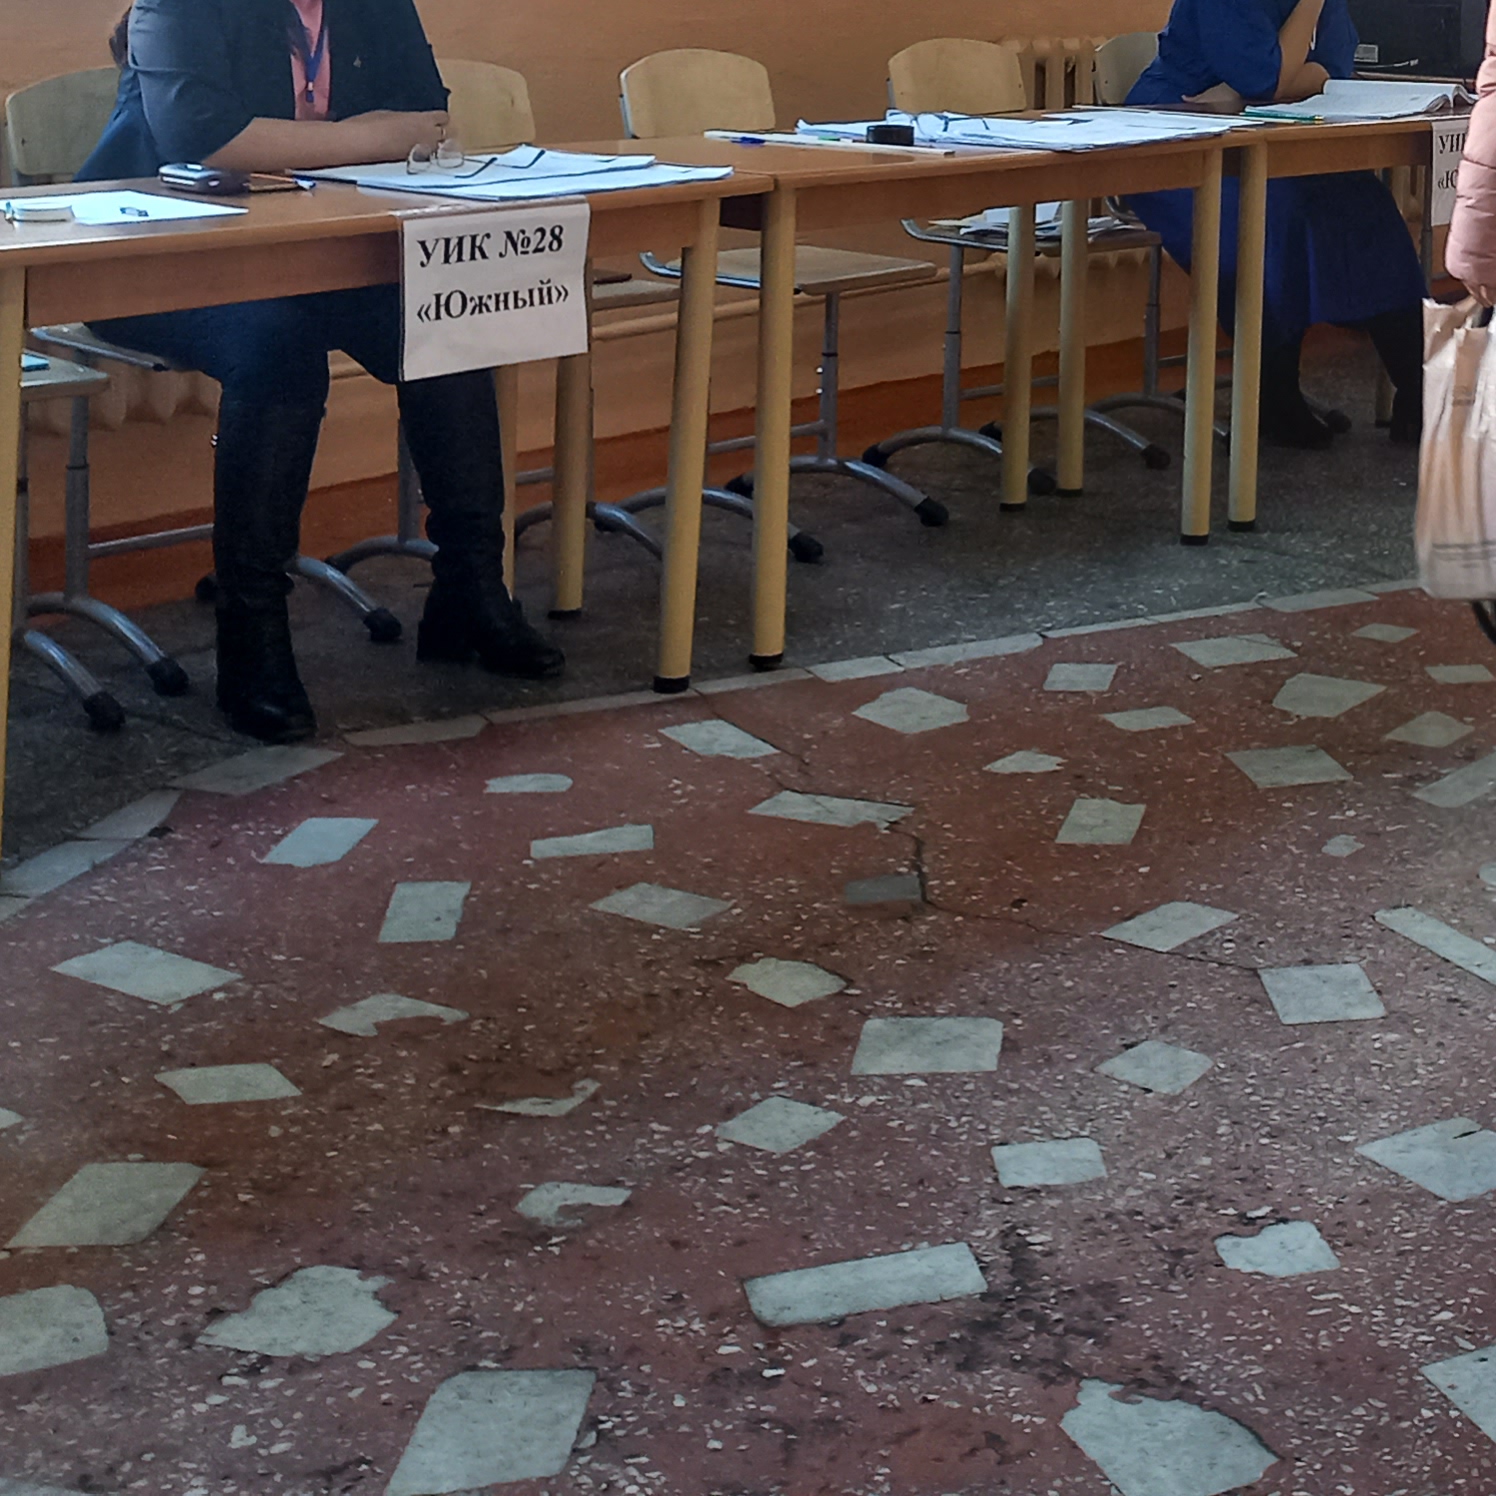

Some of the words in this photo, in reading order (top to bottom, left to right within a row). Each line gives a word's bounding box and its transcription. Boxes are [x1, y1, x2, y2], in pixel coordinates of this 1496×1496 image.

[416, 232, 492, 269] УИК
[498, 224, 564, 259] №28
[416, 278, 570, 324] «Южный»
